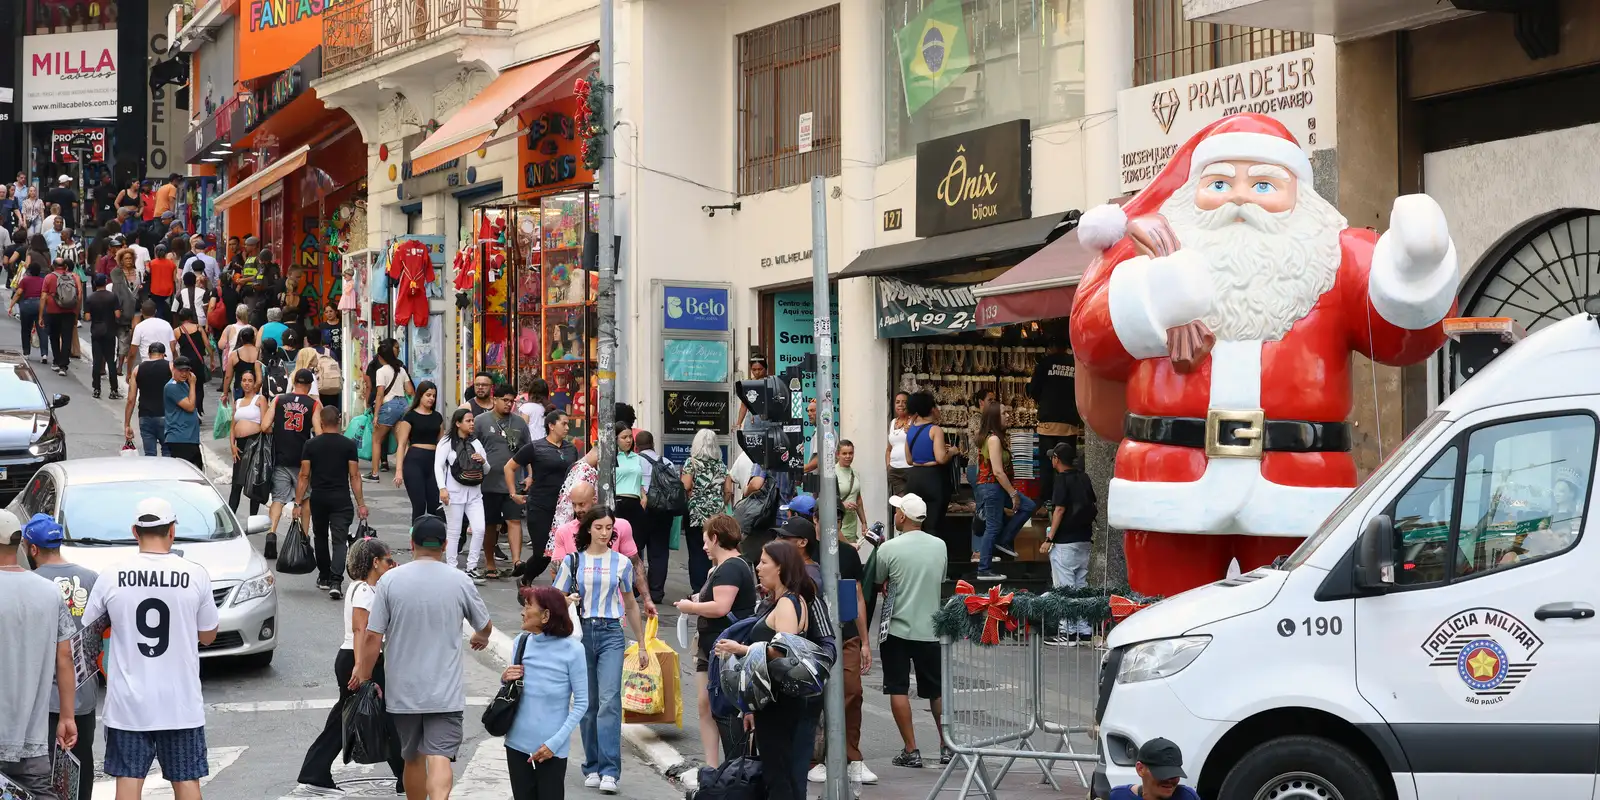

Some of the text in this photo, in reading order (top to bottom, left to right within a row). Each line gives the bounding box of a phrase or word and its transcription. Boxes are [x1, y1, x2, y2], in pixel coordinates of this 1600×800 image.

[32, 48, 115, 76] MILLA
[60, 66, 116, 80] cabelos
[1188, 57, 1316, 112] PRATA DE 15 R
[122, 105, 133, 114] 85
[1276, 90, 1313, 110] VAREJO
[937, 143, 999, 207] Ônix
[884, 210, 901, 230] 127
[972, 203, 998, 221] bijoux
[685, 296, 725, 316] Beto
[782, 308, 799, 316] Aqui
[907, 312, 947, 332] 1,99
[1052, 364, 1075, 372] POSSO
[682, 395, 726, 412] Elegancy
[284, 411, 304, 432] 23
[118, 570, 190, 589] RONALDO
[136, 597, 170, 658] 9
[1302, 615, 1343, 637] 190
[1430, 612, 1536, 653] POLÍCIA MILITAR
[1465, 695, 1504, 705] SÃO PAULO
